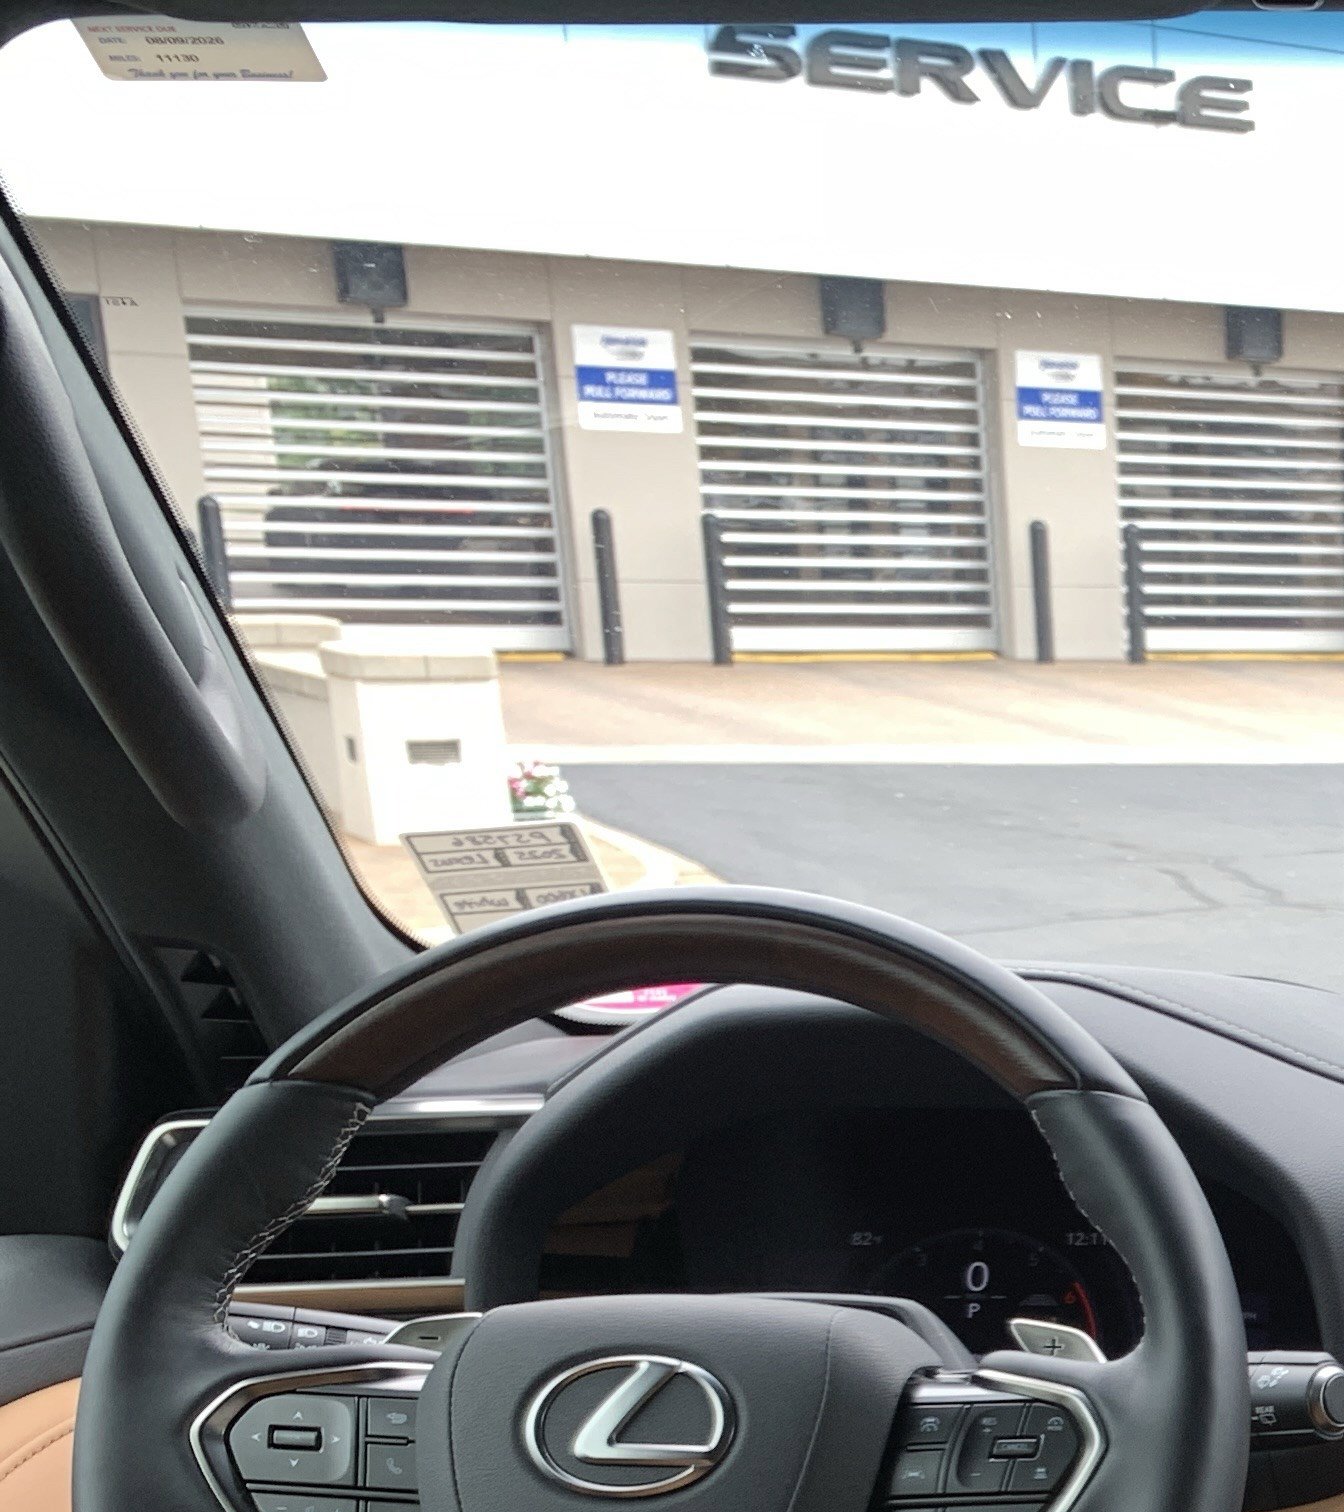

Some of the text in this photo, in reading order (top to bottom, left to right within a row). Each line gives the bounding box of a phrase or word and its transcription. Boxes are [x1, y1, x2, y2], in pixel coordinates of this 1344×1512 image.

[145, 36, 225, 45] 08/09/2026
[156, 54, 199, 63] 11130
[708, 22, 1256, 134] SERVICE
[965, 1260, 990, 1292] 0
[967, 1302, 981, 1319] P
